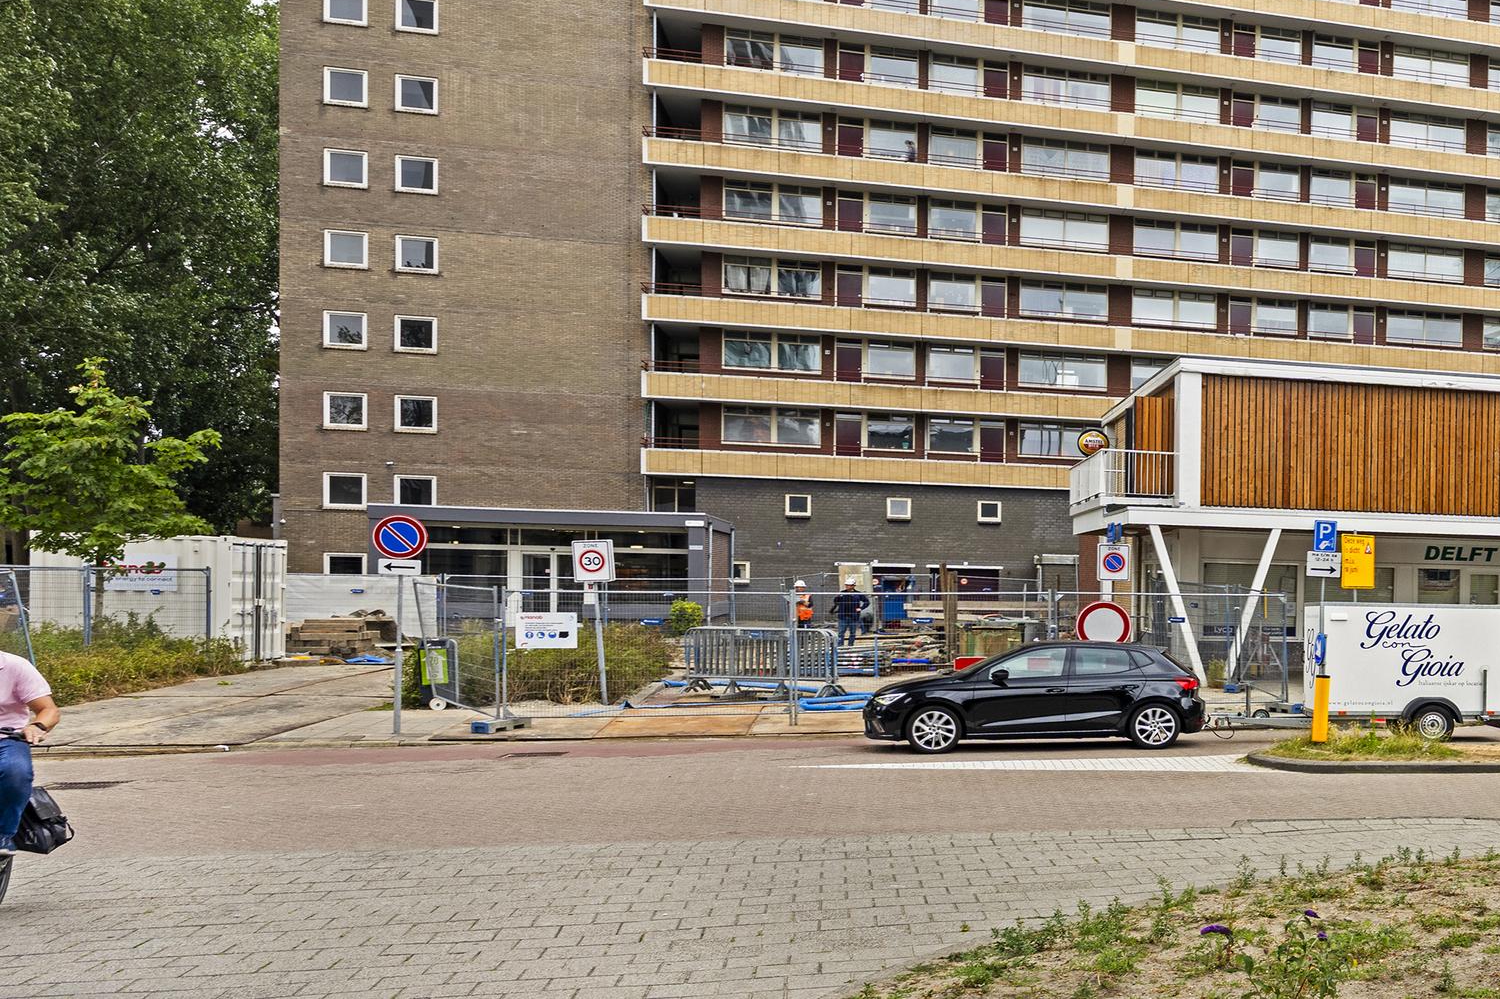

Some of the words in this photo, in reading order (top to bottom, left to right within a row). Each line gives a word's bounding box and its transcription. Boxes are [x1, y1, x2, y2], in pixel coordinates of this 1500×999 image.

[1319, 523, 1332, 539] P
[584, 556, 601, 566] 30
[1424, 545, 1498, 562] DELFT
[1360, 610, 1441, 649] Gelato
[1381, 640, 1428, 649] con
[1395, 648, 1465, 687] Gioia
